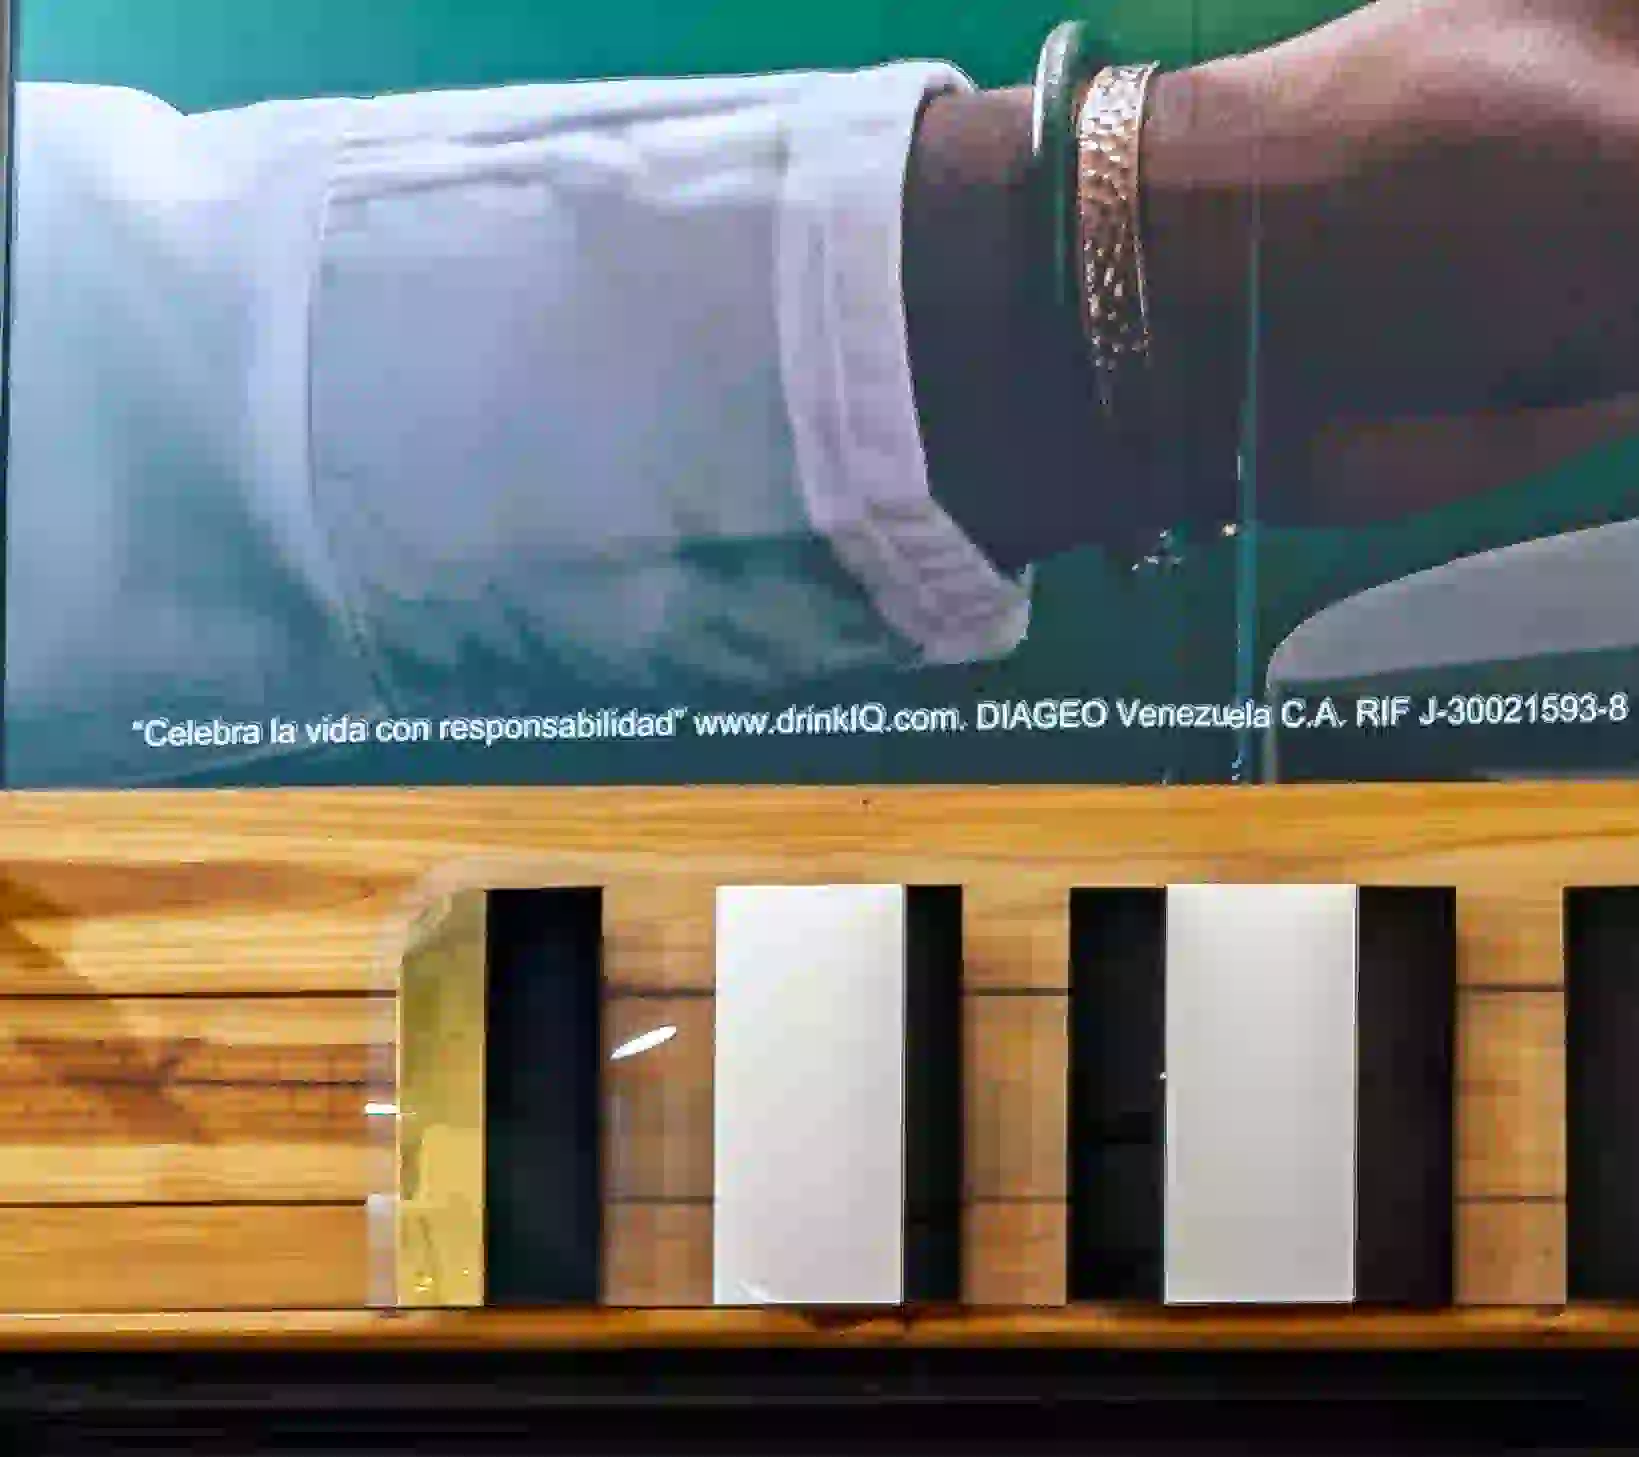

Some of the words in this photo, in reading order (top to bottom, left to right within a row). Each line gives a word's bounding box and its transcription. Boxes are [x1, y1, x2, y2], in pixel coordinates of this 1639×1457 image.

[271, 719, 297, 743] la
[303, 713, 369, 745] vida
[376, 719, 432, 741] con
[977, 699, 1108, 729] DIAGEO
[1116, 700, 1274, 729] Venezuela
[1280, 695, 1346, 730] C.A.
[1357, 696, 1410, 726] RIF
[1419, 692, 1629, 725] J-30021593-8
